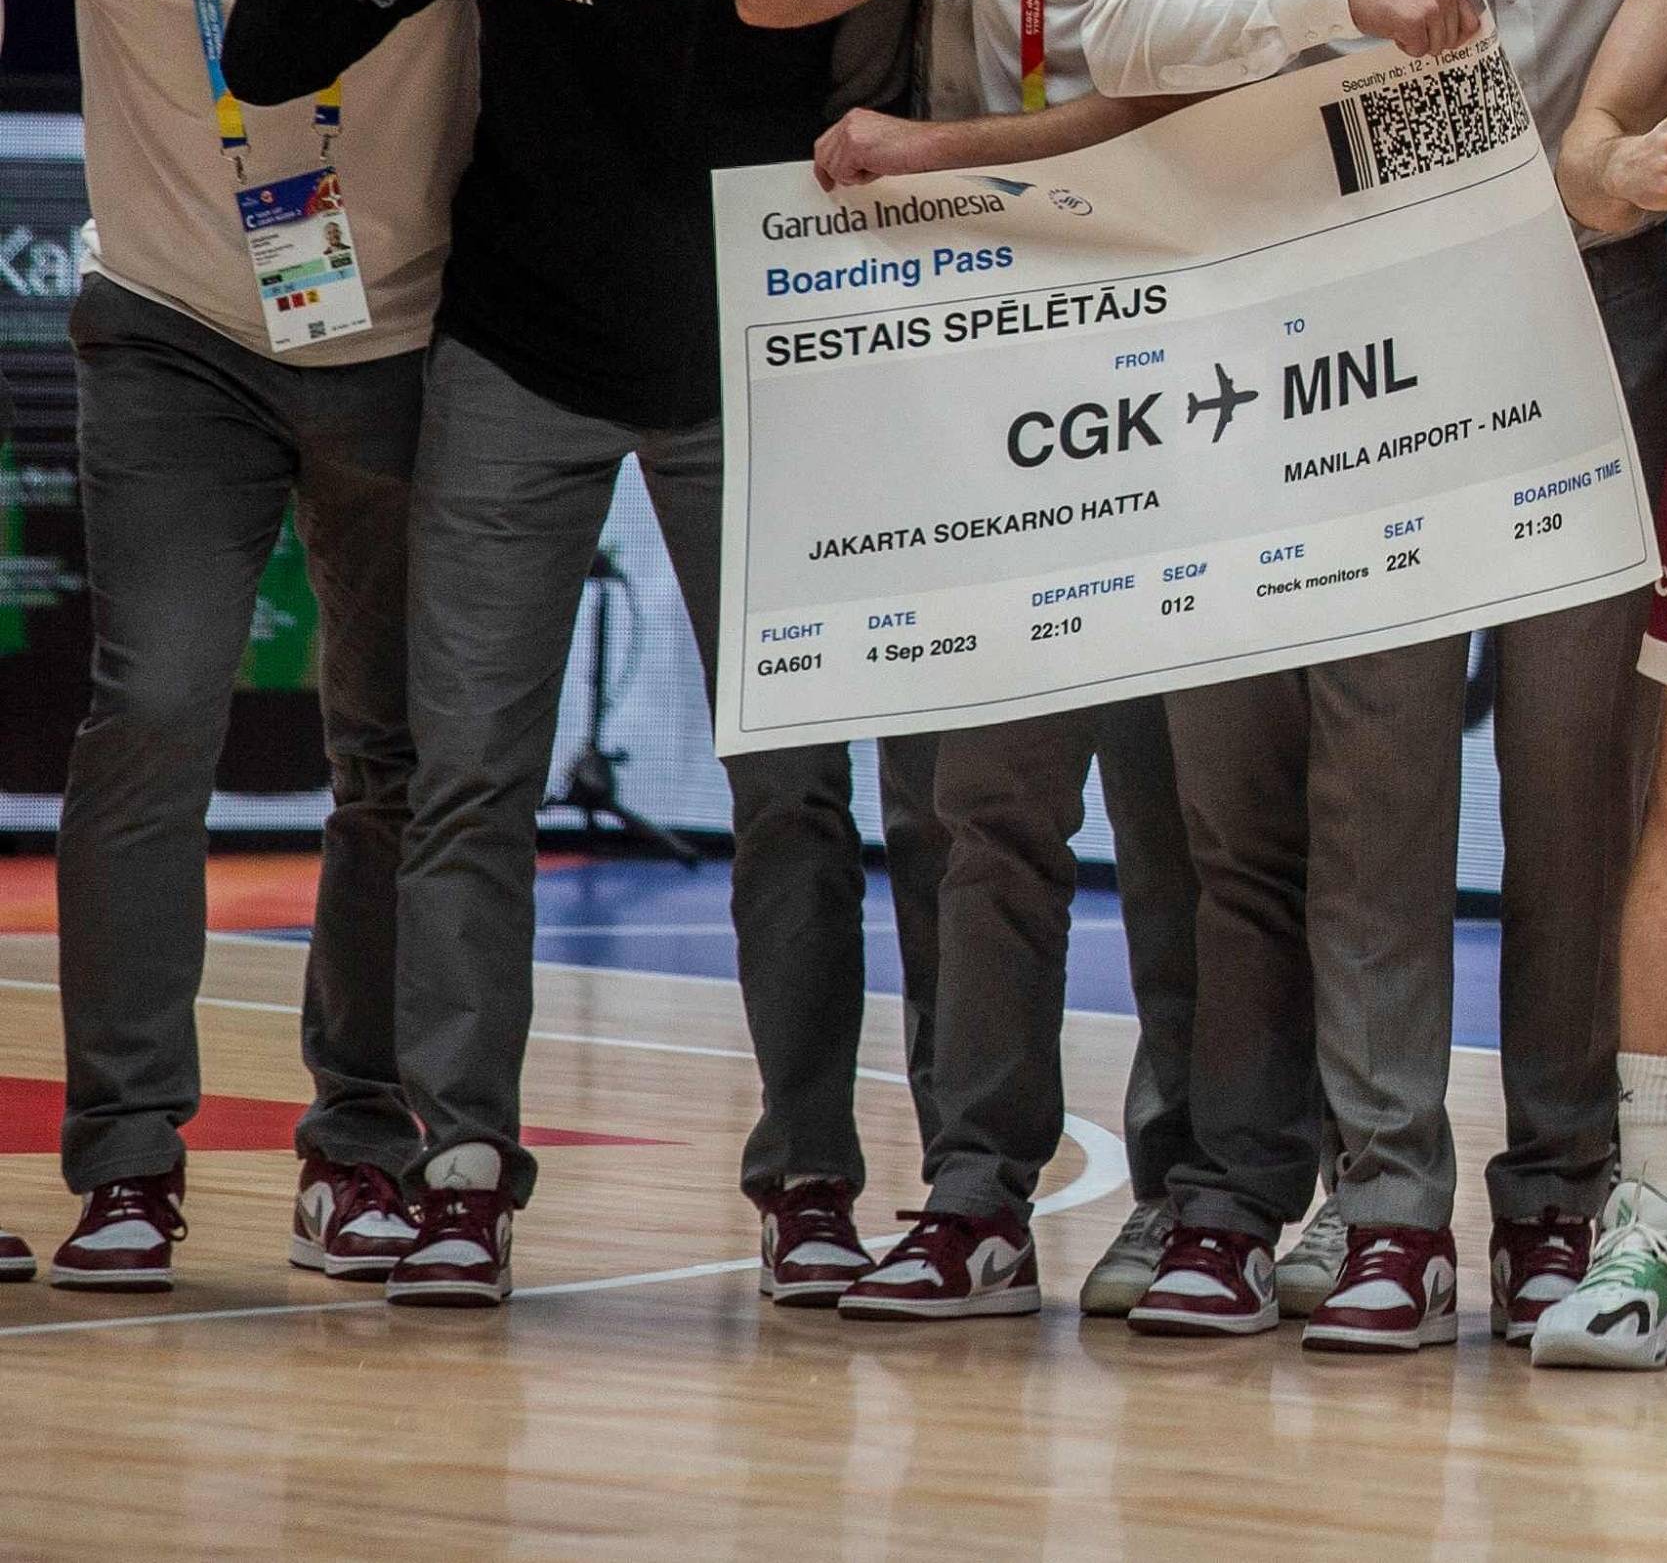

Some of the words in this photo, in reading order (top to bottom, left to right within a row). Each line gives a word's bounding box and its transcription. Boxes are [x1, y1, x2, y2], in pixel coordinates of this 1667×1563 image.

[1342, 70, 1387, 93] Security
[1409, 59, 1423, 73] 12
[762, 208, 868, 241] Garuda
[875, 193, 1005, 229] Indonesia
[766, 255, 922, 297] Boarding
[933, 245, 1014, 277] Pass
[765, 317, 931, 367] SESTAIS
[943, 284, 1168, 344] SPĒLĒTĀJS
[1284, 318, 1306, 336] TO
[1114, 348, 1165, 370] FROM
[1007, 392, 1164, 469] CGK
[1283, 337, 1418, 420] MNL
[1284, 446, 1371, 483] MANILA
[1377, 419, 1472, 463] AIRPORT
[1492, 400, 1542, 431] NAIA
[1513, 472, 1592, 507] BOARDING
[1596, 459, 1623, 483] TIME
[809, 527, 926, 561] JAKARTA
[933, 505, 1074, 544] SOEKARNO
[1080, 490, 1160, 522] HATTA
[1383, 517, 1425, 539] SEAT
[1513, 513, 1563, 540] 21:30
[1259, 544, 1305, 565] GATE
[1386, 548, 1421, 573] 22K
[1162, 562, 1208, 583] SEQ#
[1256, 579, 1301, 598] Check
[1305, 565, 1369, 590] monitors
[1031, 575, 1135, 608] DEPARTURE
[1161, 595, 1195, 616] 012
[761, 622, 824, 643] FLIGHT
[868, 610, 917, 630] DATE
[1030, 616, 1082, 641] 22:10
[866, 645, 879, 663] 4
[884, 643, 925, 667] Sep
[930, 635, 978, 657] 2023
[757, 653, 823, 677] GA601
